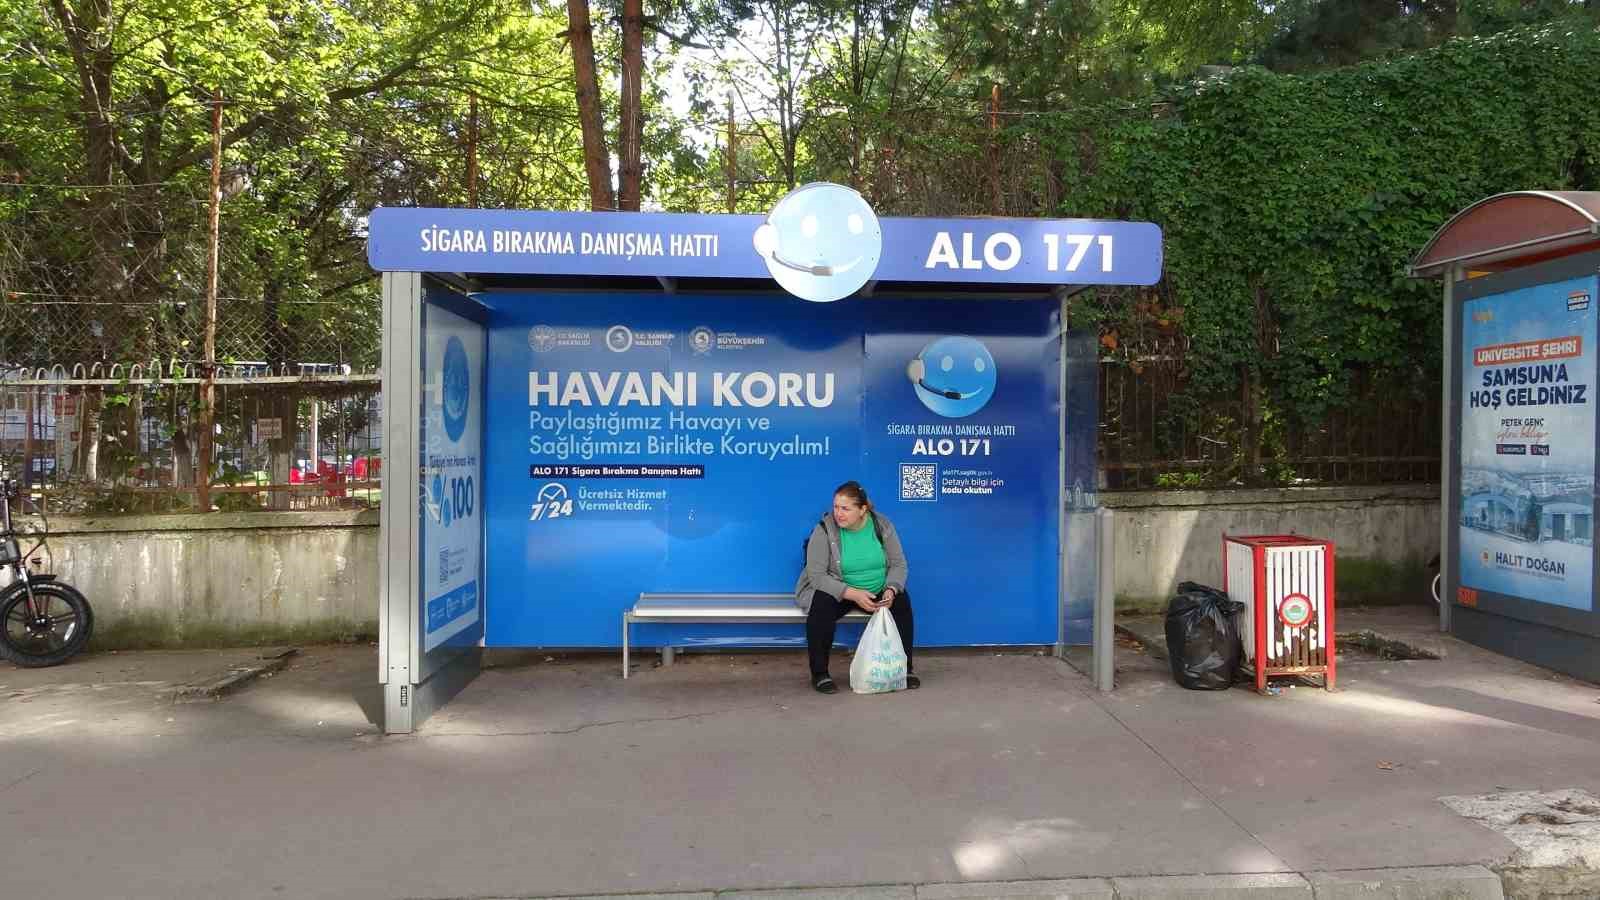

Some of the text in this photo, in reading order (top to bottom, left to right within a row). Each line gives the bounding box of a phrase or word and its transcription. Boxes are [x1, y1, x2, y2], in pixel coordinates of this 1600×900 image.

[420, 224, 718, 261] SİGARA BIRAKMA DANIŞMA HATTI
[925, 231, 1113, 272] ALO 171
[1482, 363, 1569, 387] SAMSUN'A
[528, 371, 835, 408] HAVANI KORU
[1470, 384, 1587, 410] HOŞ GELDİNİZ
[529, 409, 770, 436] Paylaştığımız Havayı ve
[887, 422, 1015, 437] SİGARA BIRAKMA DANIŞMA HATTI
[1501, 418, 1522, 427] PETEK
[529, 433, 830, 461] Sağlığımızı Birlikte Koruyalım!
[912, 438, 990, 456] ALO 171
[533, 467, 701, 477] ALO 171 Sigara Bırakma Danışma Hattı
[578, 486, 667, 499] Ücretsiz Hizmet
[942, 477, 1004, 488] Detaylı bilgi için
[942, 486, 993, 494] kodu okutun
[529, 499, 573, 521] 7/24
[578, 501, 652, 511] Vermektedir.
